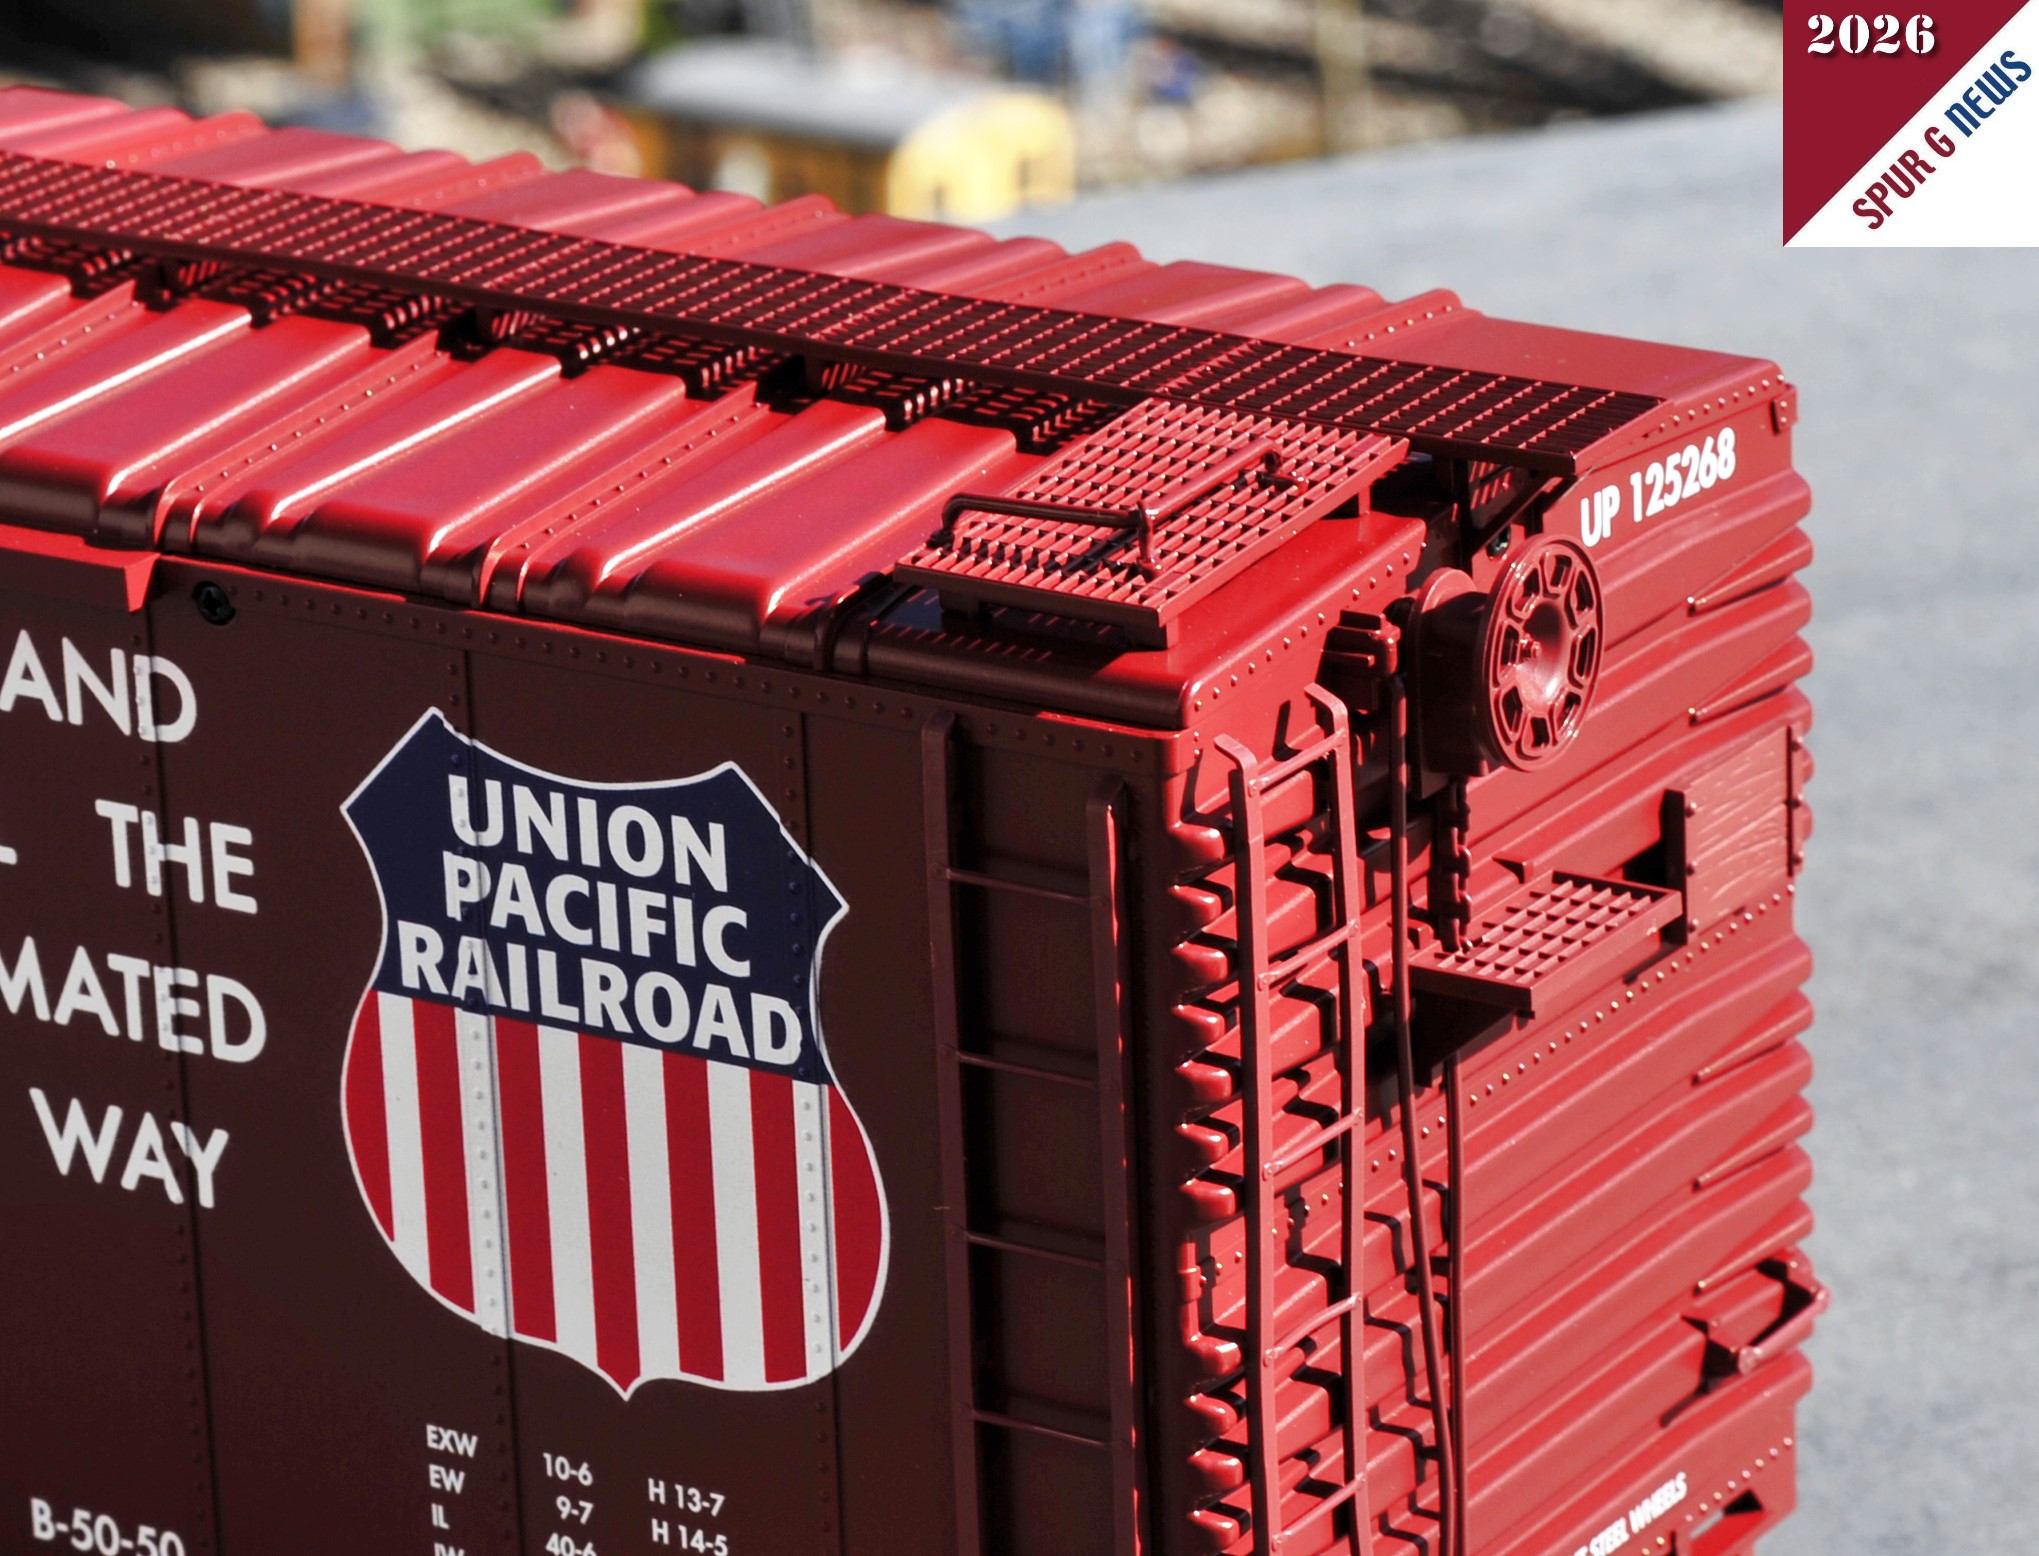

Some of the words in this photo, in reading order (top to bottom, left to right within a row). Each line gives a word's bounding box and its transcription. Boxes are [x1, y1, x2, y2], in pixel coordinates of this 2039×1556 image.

[1580, 484, 1621, 547] UP
[1629, 426, 1736, 523] 125268
[0, 629, 197, 743] AND
[95, 799, 258, 914] THE
[448, 774, 728, 893] UNION
[442, 850, 751, 978] PACIFIC
[397, 920, 803, 1066] RAILROAD
[29, 1087, 229, 1209] WAY
[31, 1497, 186, 1556] B-50-50
[426, 1424, 478, 1458] EXW
[543, 1452, 593, 1486] 10-6
[648, 1477, 666, 1505] H
[675, 1484, 725, 1517] 13-7
[429, 1464, 465, 1494] EW
[556, 1495, 594, 1525] 9-7
[652, 1518, 669, 1545] H
[678, 1525, 728, 1556] 14-5
[431, 1503, 449, 1530] IL
[1629, 1471, 1688, 1534] WHEELS
